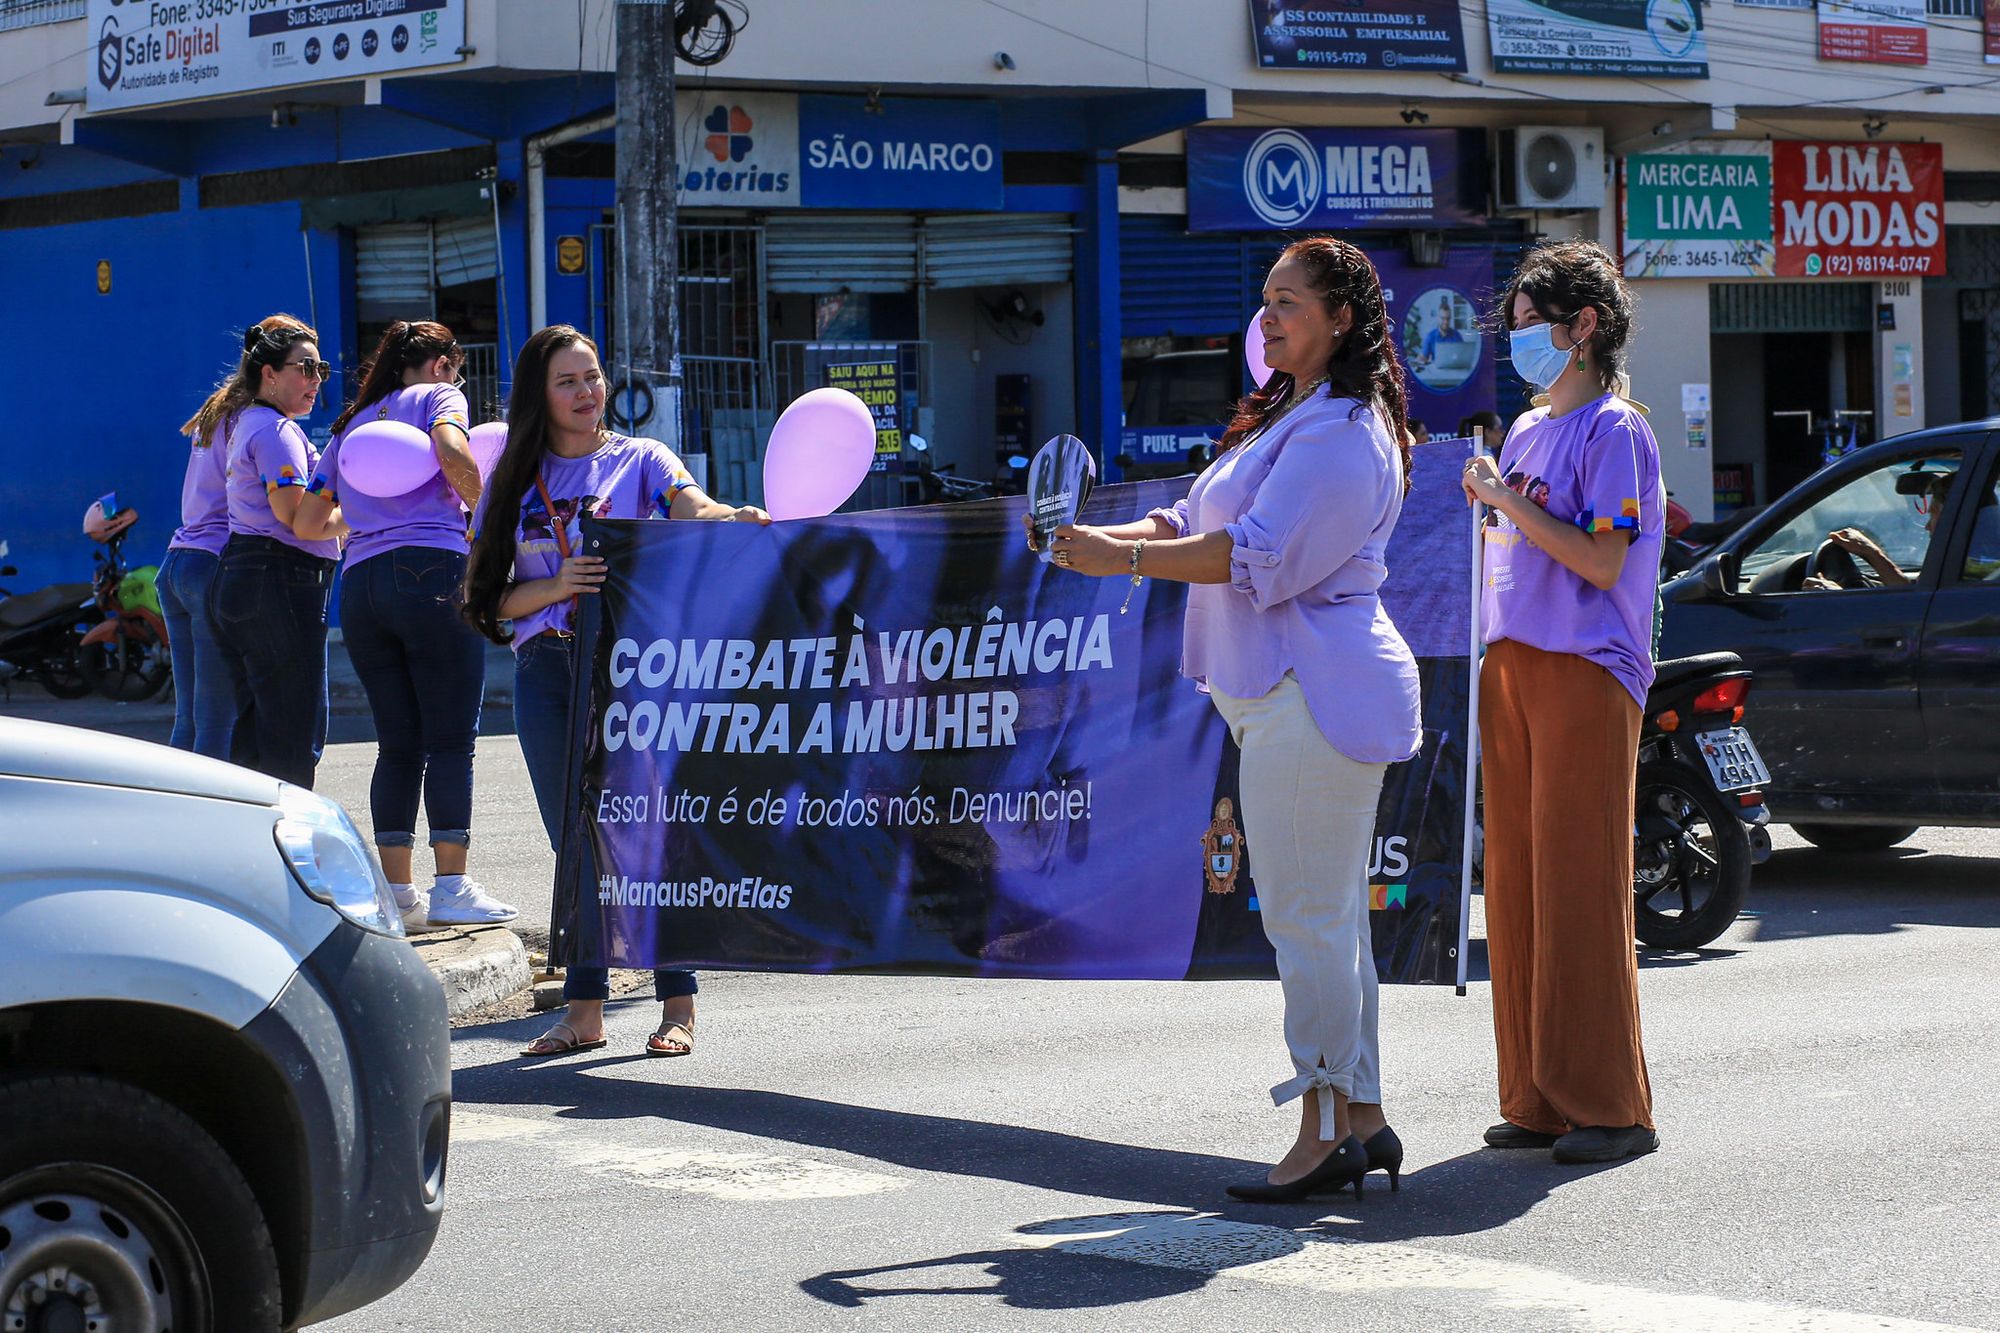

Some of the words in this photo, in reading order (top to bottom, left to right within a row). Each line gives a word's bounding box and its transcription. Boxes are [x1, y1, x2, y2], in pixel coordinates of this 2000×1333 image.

[150, 3, 191, 27] Fone:
[287, 10, 307, 26] Sua
[309, 2, 363, 24] Segurança
[421, 11, 438, 26] ICP
[1286, 10, 1306, 22] SS
[1307, 11, 1413, 25] CONTABILIDADE
[1417, 15, 1426, 24] E
[125, 33, 161, 66] Safe
[166, 23, 219, 65] Digital
[1264, 26, 1348, 38] ASSESSORIA
[1356, 28, 1450, 41] EMPRESARIAL
[272, 41, 285, 56] ITI
[120, 72, 167, 91] Autoridade
[168, 71, 180, 84] de
[182, 65, 220, 84] Registro
[808, 134, 873, 169] SÃO
[883, 141, 993, 172] MARCO
[1326, 146, 1432, 194] MEGA
[1639, 164, 1758, 187] MERCEARIA
[1802, 146, 1913, 192] LIMA
[1326, 197, 1363, 210] CURSOS
[1363, 197, 1370, 209] E
[1370, 197, 1434, 209] TREINAMENTOS
[1656, 195, 1742, 230] LIMA
[1782, 200, 1939, 247] MODAS
[1645, 251, 1682, 266] Fone:
[1826, 255, 1852, 275] (92)
[1856, 255, 1930, 273] 98194-0747
[1884, 281, 1911, 297] 2101
[830, 366, 852, 378] SAIU
[856, 365, 878, 377] AQUI
[881, 364, 895, 375] NA
[855, 388, 896, 405] RÊMIO
[884, 405, 897, 416] DA
[1143, 434, 1176, 453] PUXE
[608, 637, 837, 690] COMBATE
[840, 613, 871, 687] À
[880, 605, 1114, 684] VIOLÊNCIA
[602, 700, 790, 754] CONTRA
[797, 703, 833, 754] A
[842, 690, 1019, 753] MULHER
[596, 789, 648, 824] Essa
[655, 786, 710, 824] luta
[718, 788, 738, 825] é
[747, 789, 786, 825] de
[796, 790, 880, 827] todos
[887, 785, 940, 826] nós.
[949, 778, 1093, 825] Denuncie!
[599, 874, 793, 910] #ManausPorElas
